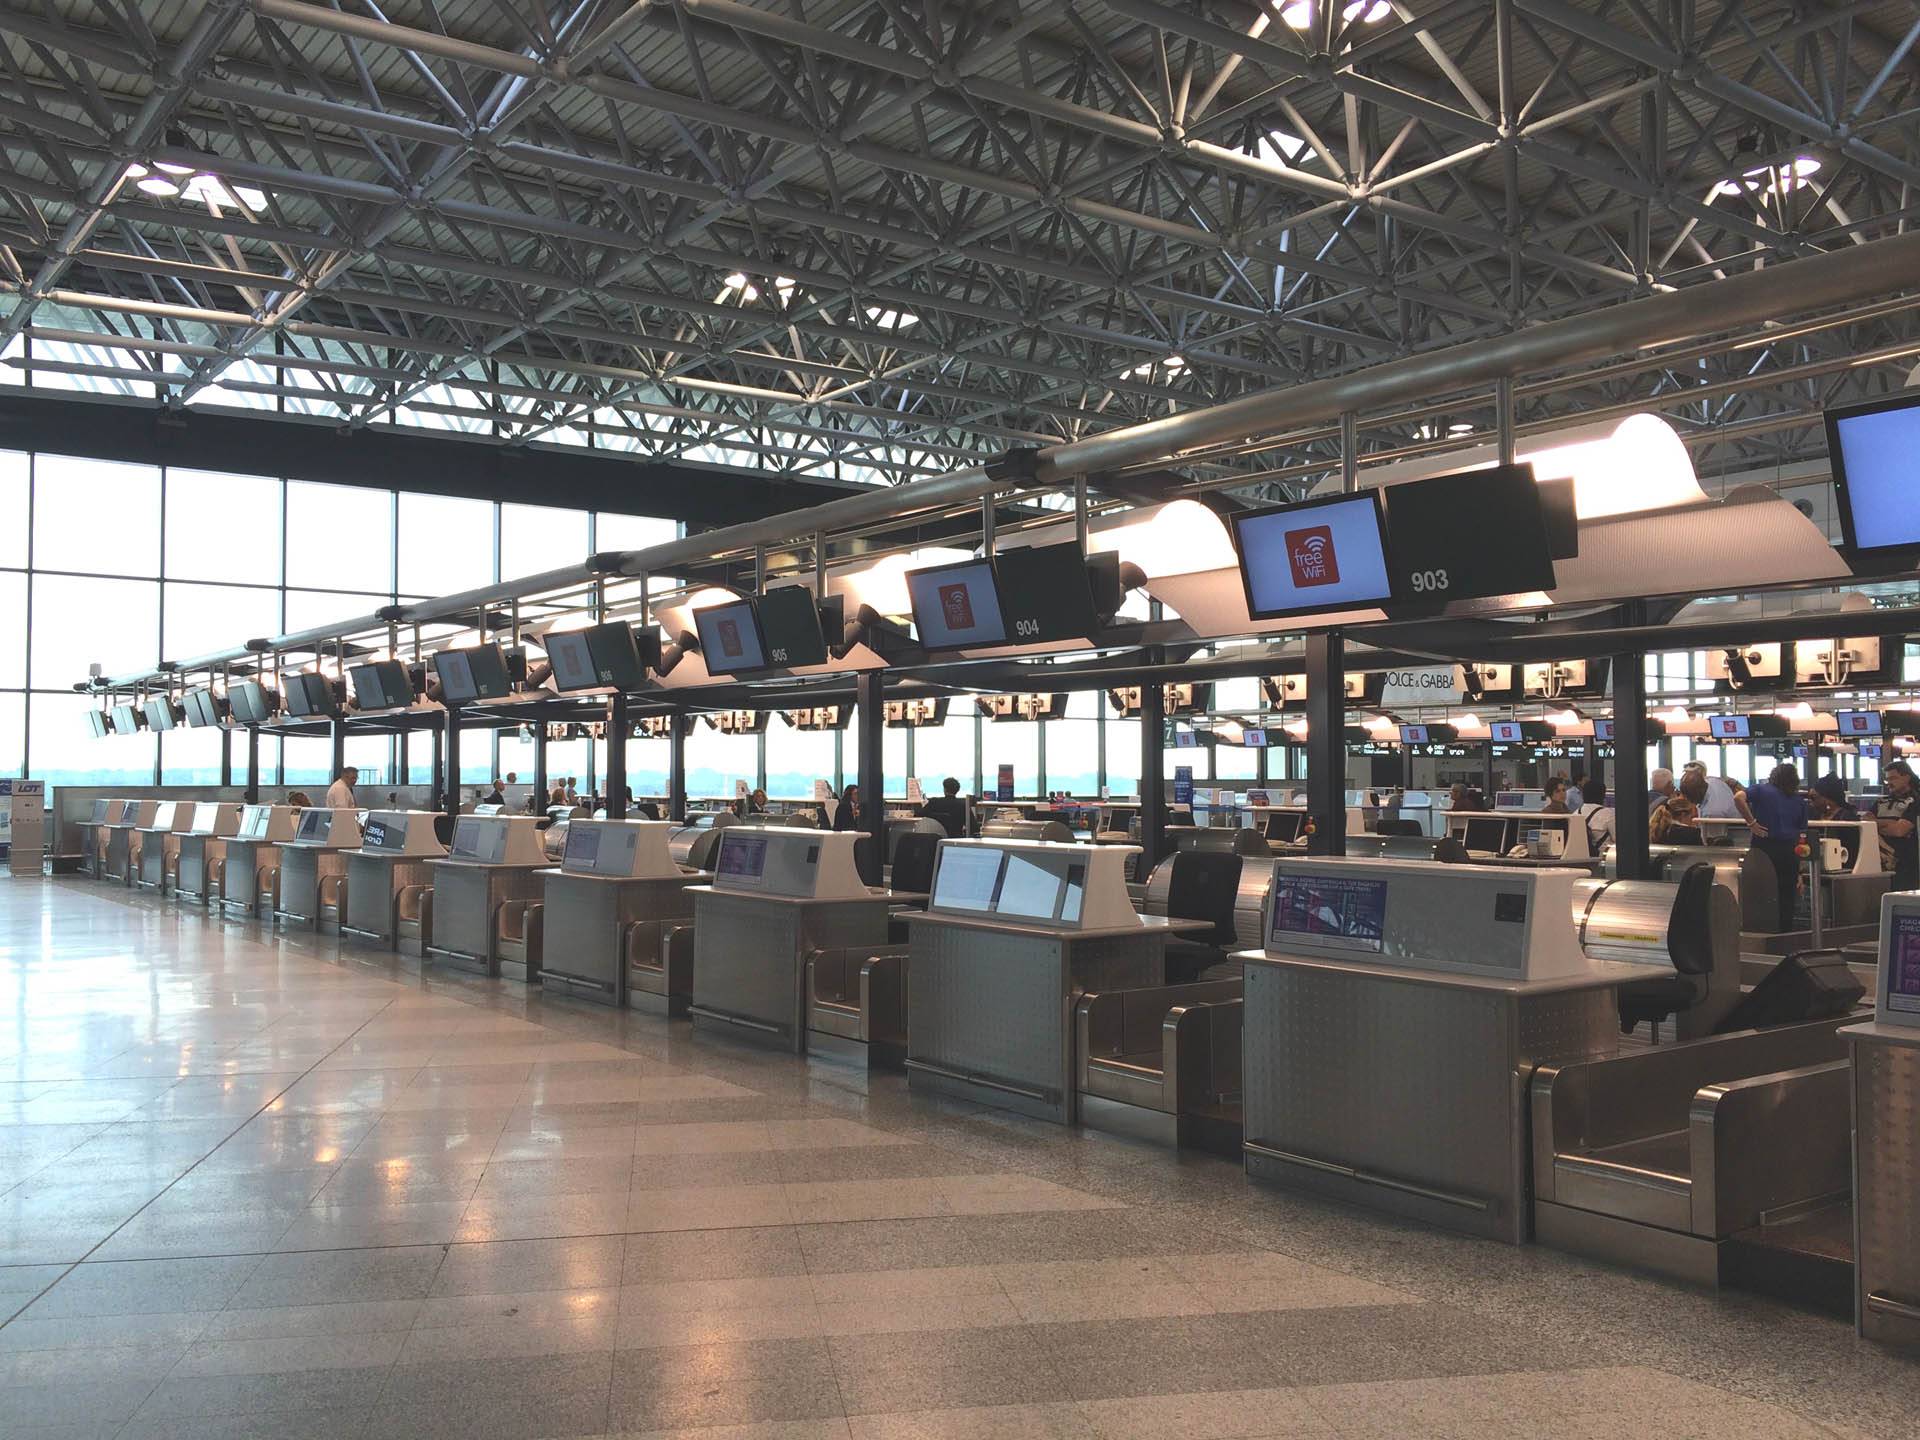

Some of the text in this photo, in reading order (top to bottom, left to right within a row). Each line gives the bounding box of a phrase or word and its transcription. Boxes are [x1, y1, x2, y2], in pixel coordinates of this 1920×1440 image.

[1294, 548, 1323, 567] free
[1302, 565, 1326, 579] WiFi
[1411, 569, 1449, 592] 903
[1016, 618, 1040, 637] 904
[772, 648, 788, 662] 905
[1165, 727, 1172, 740] 7
[1778, 743, 1785, 753] 5
[18, 784, 42, 793] LOT
